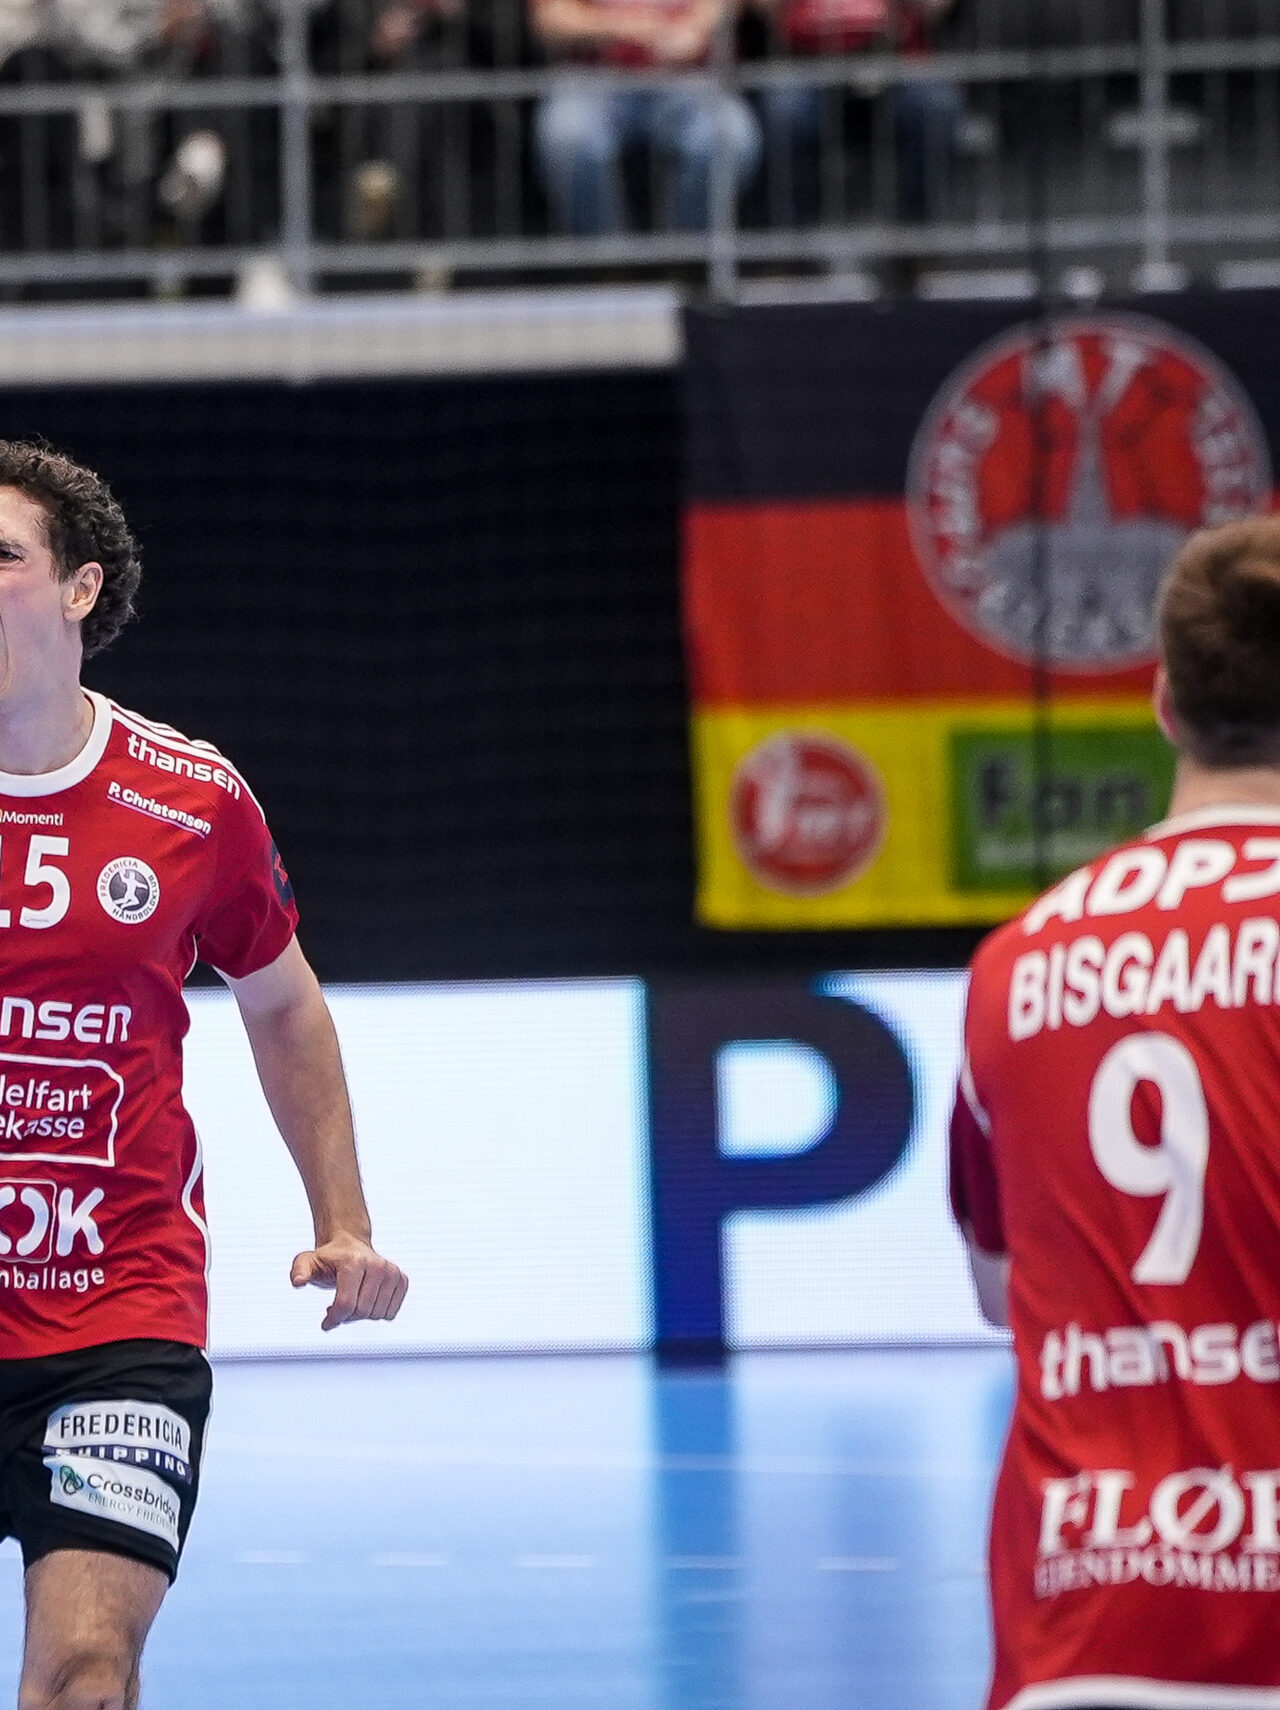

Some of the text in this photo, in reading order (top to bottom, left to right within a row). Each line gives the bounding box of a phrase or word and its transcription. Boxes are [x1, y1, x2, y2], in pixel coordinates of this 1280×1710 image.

[127, 733, 241, 800] thansen
[2, 810, 64, 826] Momenti
[1007, 914, 1280, 1042] BISGAAR
[1087, 1030, 1210, 1286] 9
[1040, 1319, 1280, 1401] thanse
[60, 1413, 183, 1451] FREDERICIA
